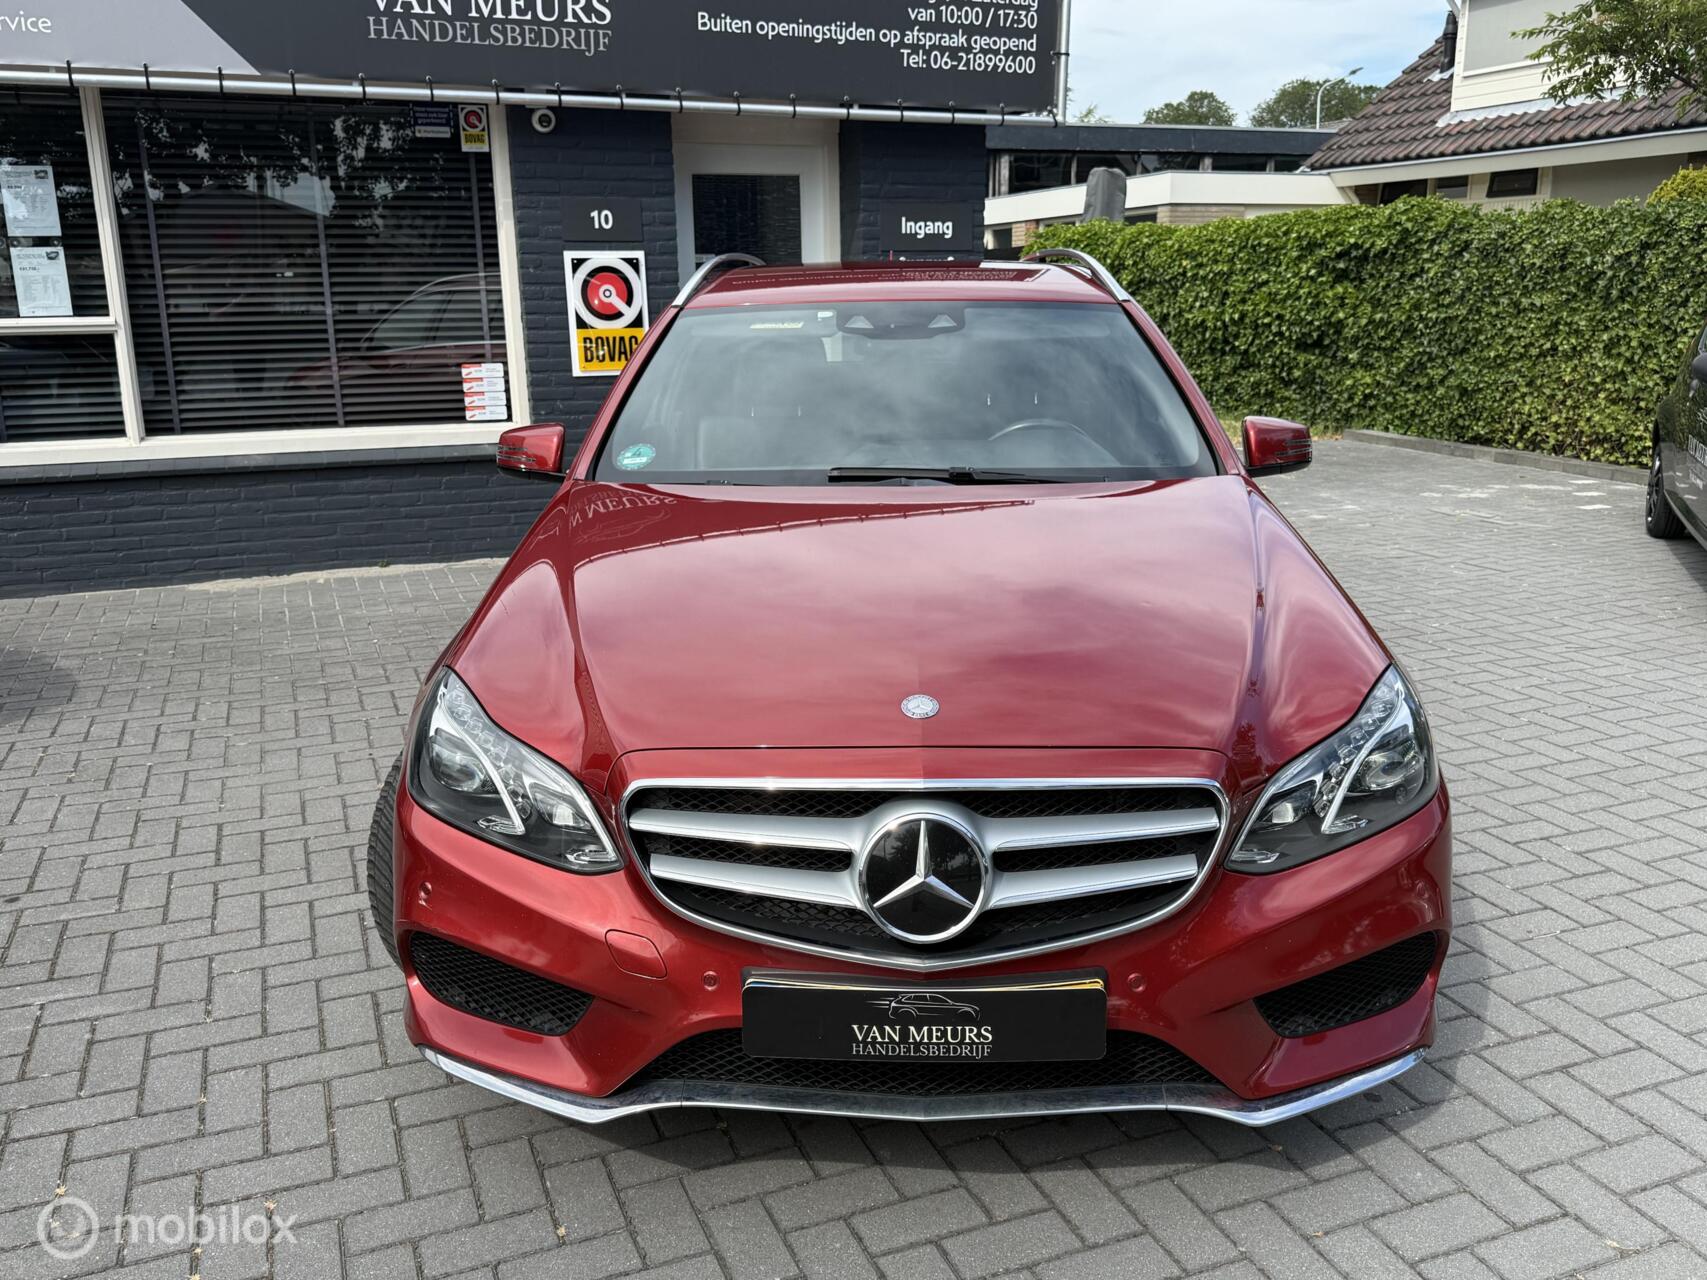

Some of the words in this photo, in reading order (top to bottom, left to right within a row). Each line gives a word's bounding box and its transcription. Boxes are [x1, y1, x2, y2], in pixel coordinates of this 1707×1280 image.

[467, 0, 612, 25] MEURS
[907, 7, 936, 22] van
[939, 5, 983, 25] 10:00
[985, 7, 995, 28] /
[997, 9, 1038, 29] 17:30
[366, 16, 612, 57] HANDELSBEDRIJF
[697, 11, 752, 34] Buiten
[755, 19, 876, 45] openingstijden
[878, 29, 901, 47] op
[903, 25, 968, 50] afspraak
[970, 33, 1037, 55] geopend
[900, 49, 927, 68] Tel:
[930, 50, 1036, 74] 06-21899600
[590, 209, 613, 230] 10
[901, 216, 953, 239] Ingang
[851, 1024, 901, 1042] VAN
[907, 1025, 993, 1043] MEURS
[851, 1043, 993, 1060] HANDELSBEDRIJF
